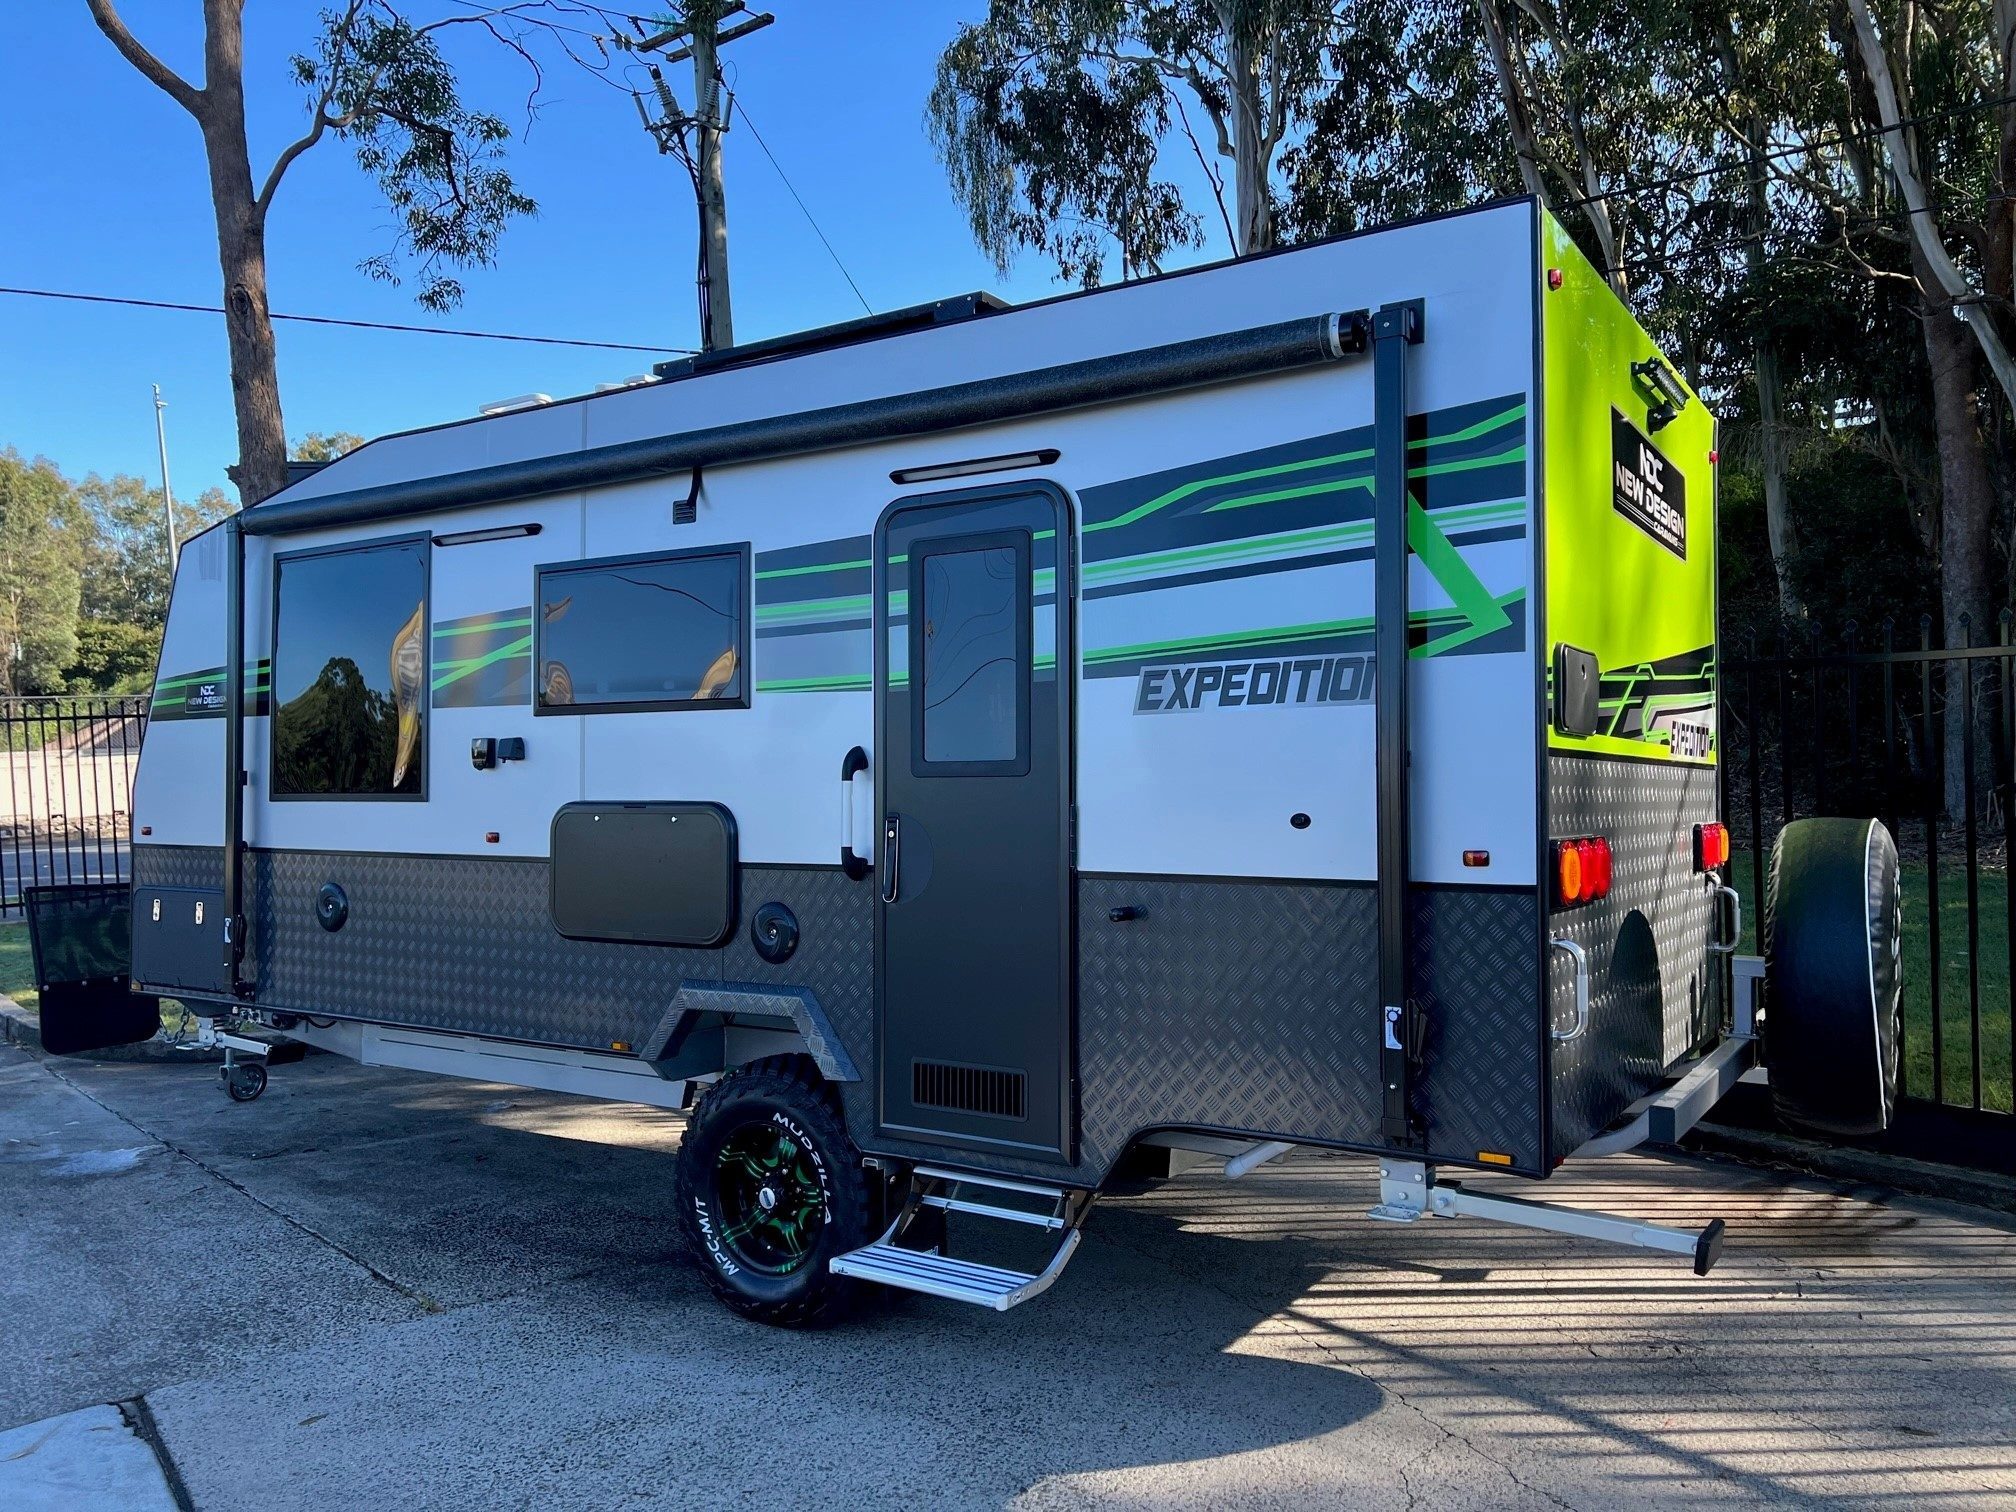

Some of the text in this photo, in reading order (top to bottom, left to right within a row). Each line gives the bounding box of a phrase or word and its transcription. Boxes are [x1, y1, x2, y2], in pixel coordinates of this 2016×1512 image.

[1640, 442, 1664, 493] NDC
[1616, 460, 1685, 539] NEW DESIGN
[187, 696, 227, 705] NEW DESIGN
[200, 685, 215, 696] NDC
[1670, 720, 1710, 758] EXPEDITION
[773, 1112, 832, 1225] MUDZILLA
[695, 1196, 740, 1276] MPC-M/T
